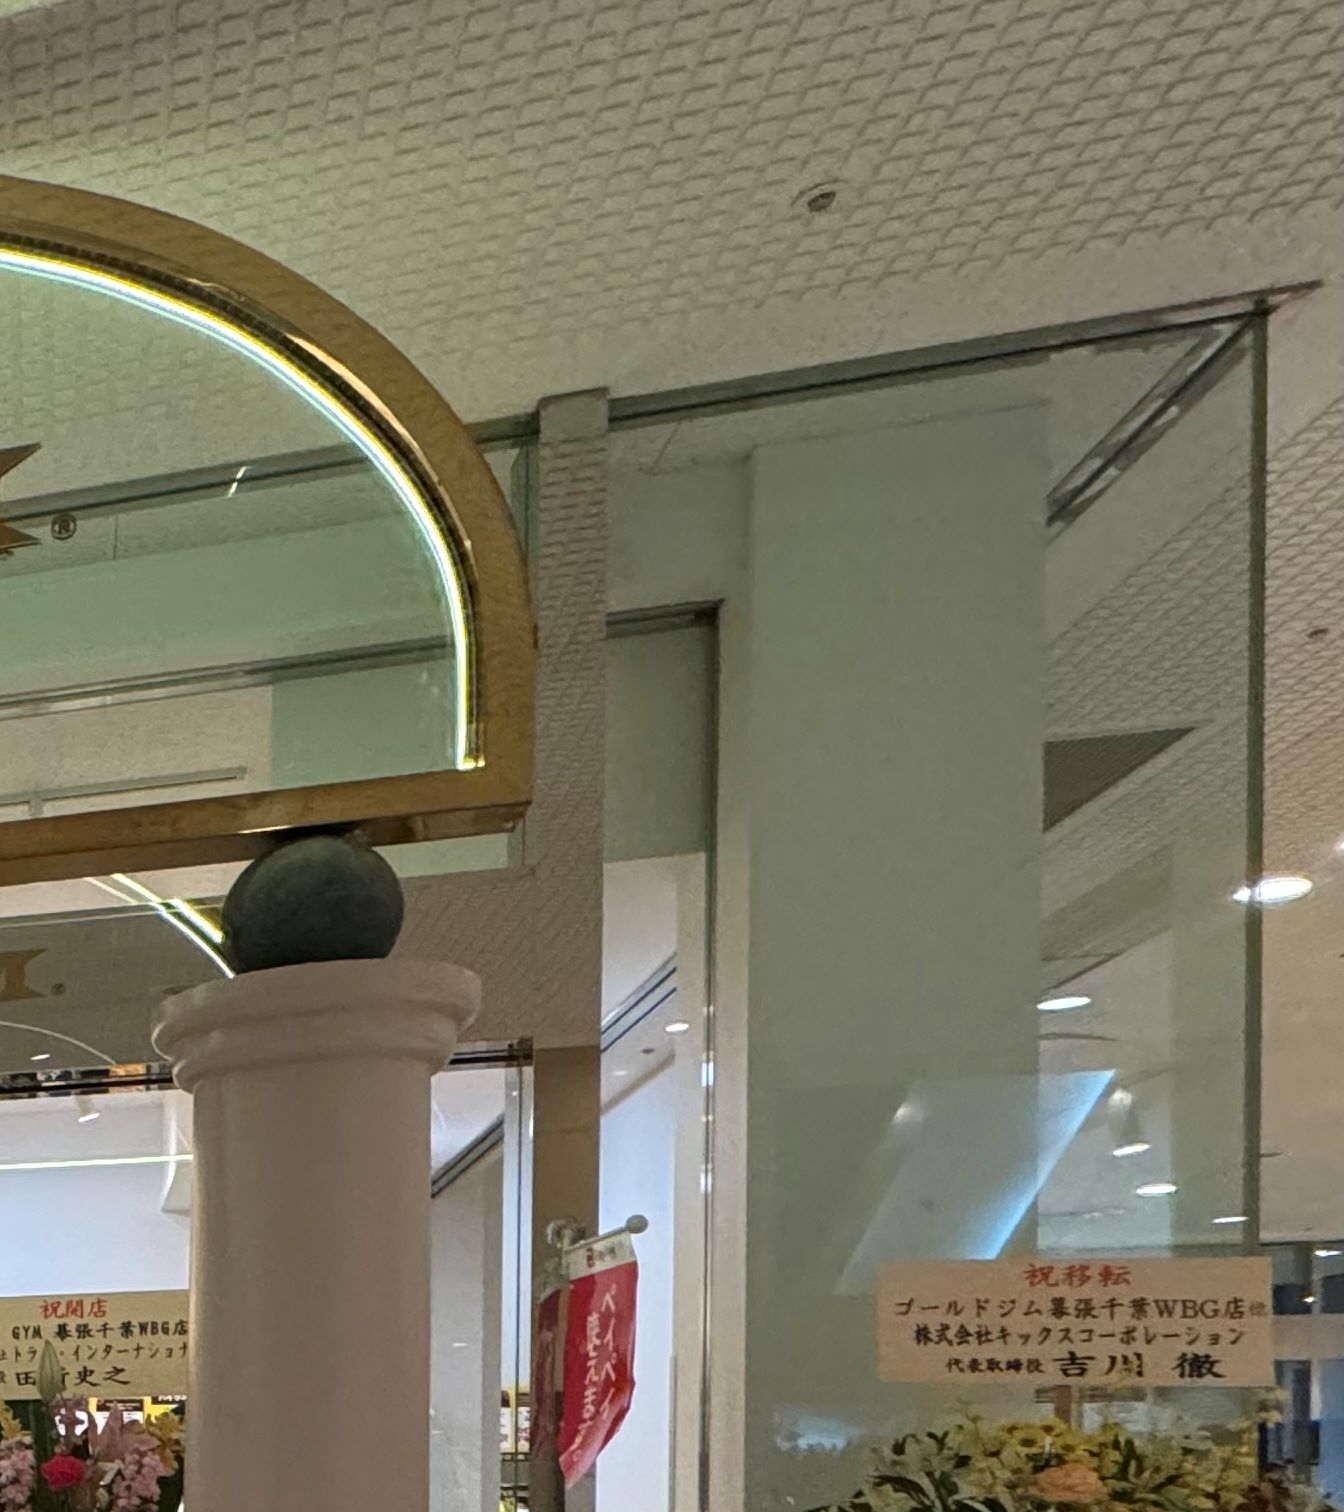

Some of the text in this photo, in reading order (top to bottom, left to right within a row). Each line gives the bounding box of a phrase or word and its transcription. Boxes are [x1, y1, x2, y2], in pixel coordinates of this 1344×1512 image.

[1023, 1262, 1132, 1289] 祝移転
[40, 1298, 109, 1320] 祝開店
[12, 1324, 43, 1341] GYM
[912, 1322, 1247, 1348] 株式会社キックスコーポレーション
[946, 1356, 1047, 1375] 代表取締役
